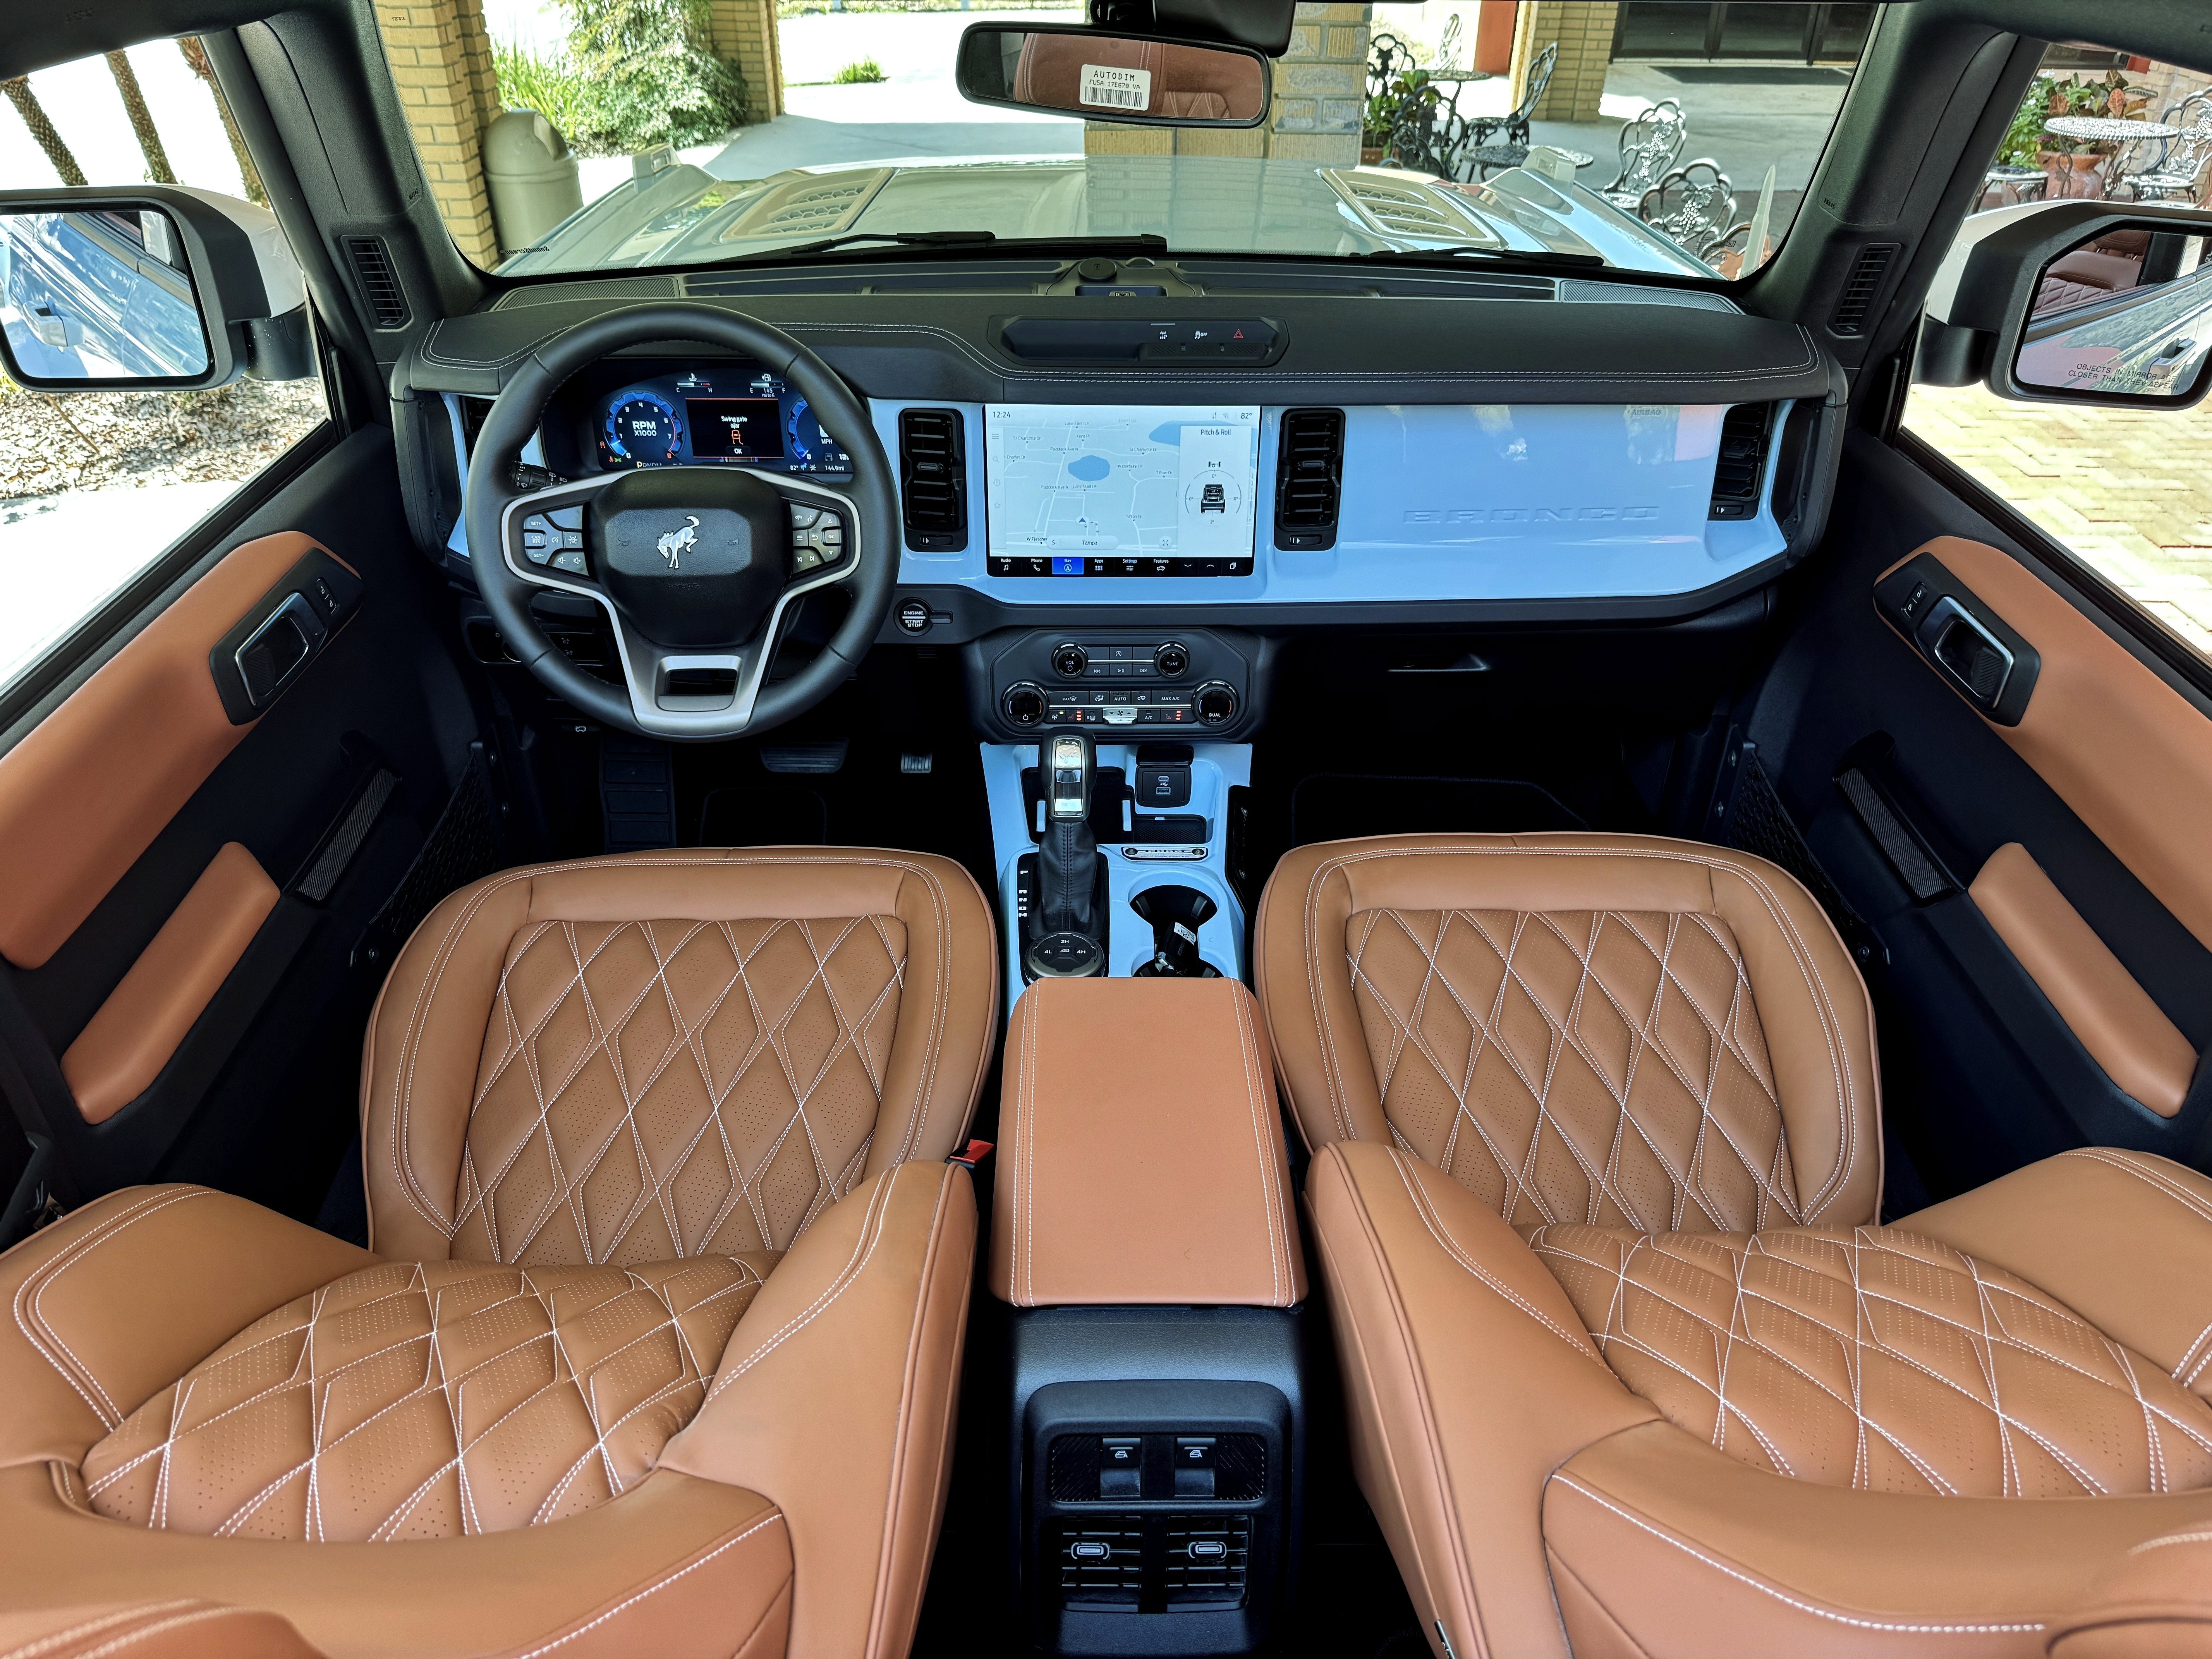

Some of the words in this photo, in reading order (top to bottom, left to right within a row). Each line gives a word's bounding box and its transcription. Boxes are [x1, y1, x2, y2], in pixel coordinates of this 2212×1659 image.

[1094, 70, 1135, 81] AUTODIM
[2076, 363, 2111, 374] OBJECTS
[2127, 370, 2157, 379] MIRROR
[2068, 370, 2098, 380] CLOSER
[2127, 378, 2145, 386] THEY
[2149, 381, 2179, 390] APPEAR
[632, 421, 656, 430] RPM
[1403, 506, 1659, 524] BRONCO
